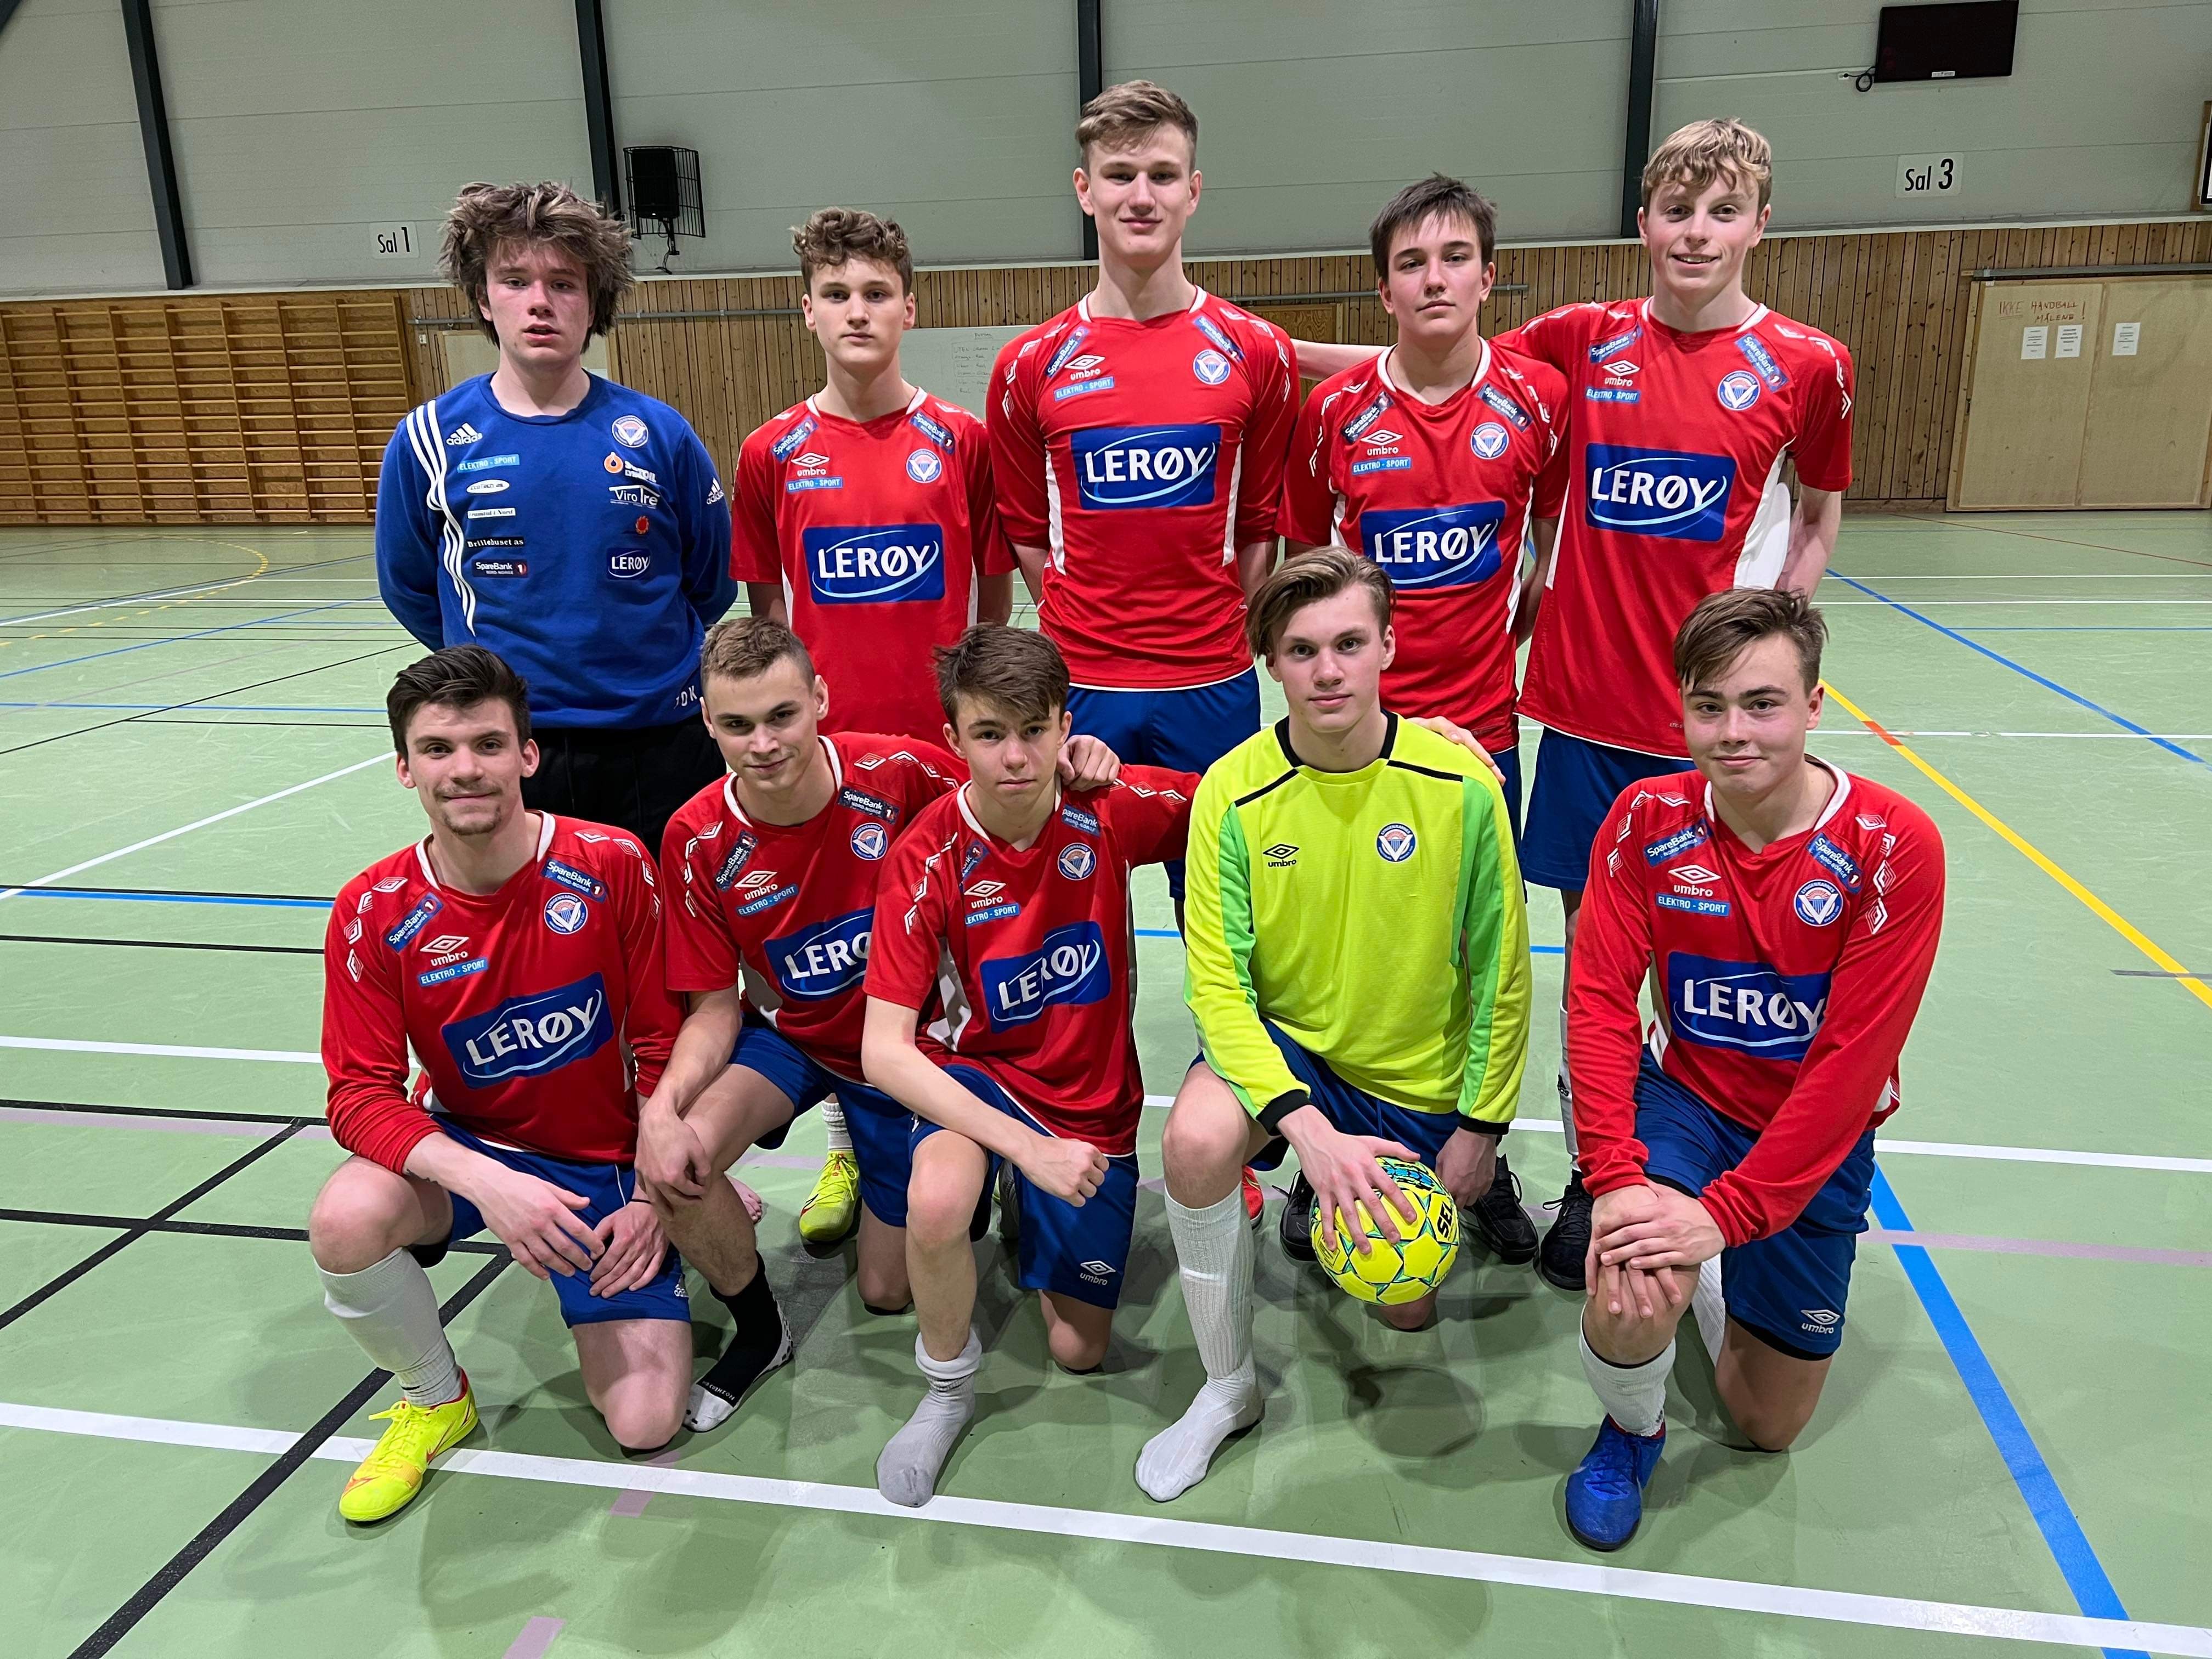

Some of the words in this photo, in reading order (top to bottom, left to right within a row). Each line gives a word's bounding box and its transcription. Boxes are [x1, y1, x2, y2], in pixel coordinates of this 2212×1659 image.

[1905, 165, 1931, 191] Sal
[1938, 159, 1954, 189] 3
[378, 232, 398, 253] Sal
[401, 227, 410, 252] 1
[1999, 301, 2024, 314] IKKE
[2031, 301, 2078, 313] HANDBALL
[1592, 336, 1629, 356] SpareBank
[1744, 336, 1774, 374] SpareBank
[1048, 338, 1075, 374] SpareBank
[1070, 369, 1101, 381] umbro
[1605, 377, 1633, 386] umbro
[1056, 385, 1083, 398] ELEKTRO
[1089, 379, 1111, 388] SPORT
[1616, 391, 1638, 400] SPORT
[1485, 387, 1517, 415] SpareBank
[913, 413, 945, 439] SpareBank
[1345, 406, 1378, 436] SpareBank
[447, 433, 483, 445] adidas
[1367, 445, 1398, 456] umbro
[494, 456, 516, 465] SPORT
[1085, 447, 1208, 483] LERØY
[1353, 461, 1380, 472] ELEKTRO
[1386, 459, 1408, 467] SPORT
[797, 468, 826, 477] umbro
[788, 480, 814, 490] ELEKTRO
[1592, 466, 1717, 509] LERØY
[1375, 519, 1492, 563] LERØY
[476, 562, 512, 571] SpareBank
[611, 555, 649, 570] LERØY
[818, 545, 930, 579] LERØY
[844, 791, 883, 810] SpareBank
[1062, 809, 1097, 827] pareBank
[1647, 830, 1695, 857] SpareBank
[1268, 859, 1296, 868] umbro
[1815, 838, 1853, 873] SpareBank
[716, 847, 743, 884] SpareBank
[547, 861, 591, 888] SpareBank
[594, 886, 600, 894] 1
[738, 899, 768, 915] ELEKTRO
[773, 886, 795, 902] SPORT
[744, 884, 778, 900] umbro
[1674, 885, 1713, 897] umbro
[971, 896, 1003, 909] umbro
[1658, 896, 1690, 909] ELEKTRO
[1699, 902, 1726, 913] SPORT
[966, 912, 988, 924] LEKTRO
[994, 906, 1016, 916] SPORT
[388, 909, 424, 944] SpareBank
[431, 951, 468, 966] umbro
[421, 968, 455, 984] ELEKTRO
[462, 960, 485, 972] SPORT
[1684, 979, 1825, 1033] LERØY
[465, 997, 595, 1066] LERØY
[1080, 1273, 1108, 1285] umbro
[1802, 1323, 1834, 1334] umbro
